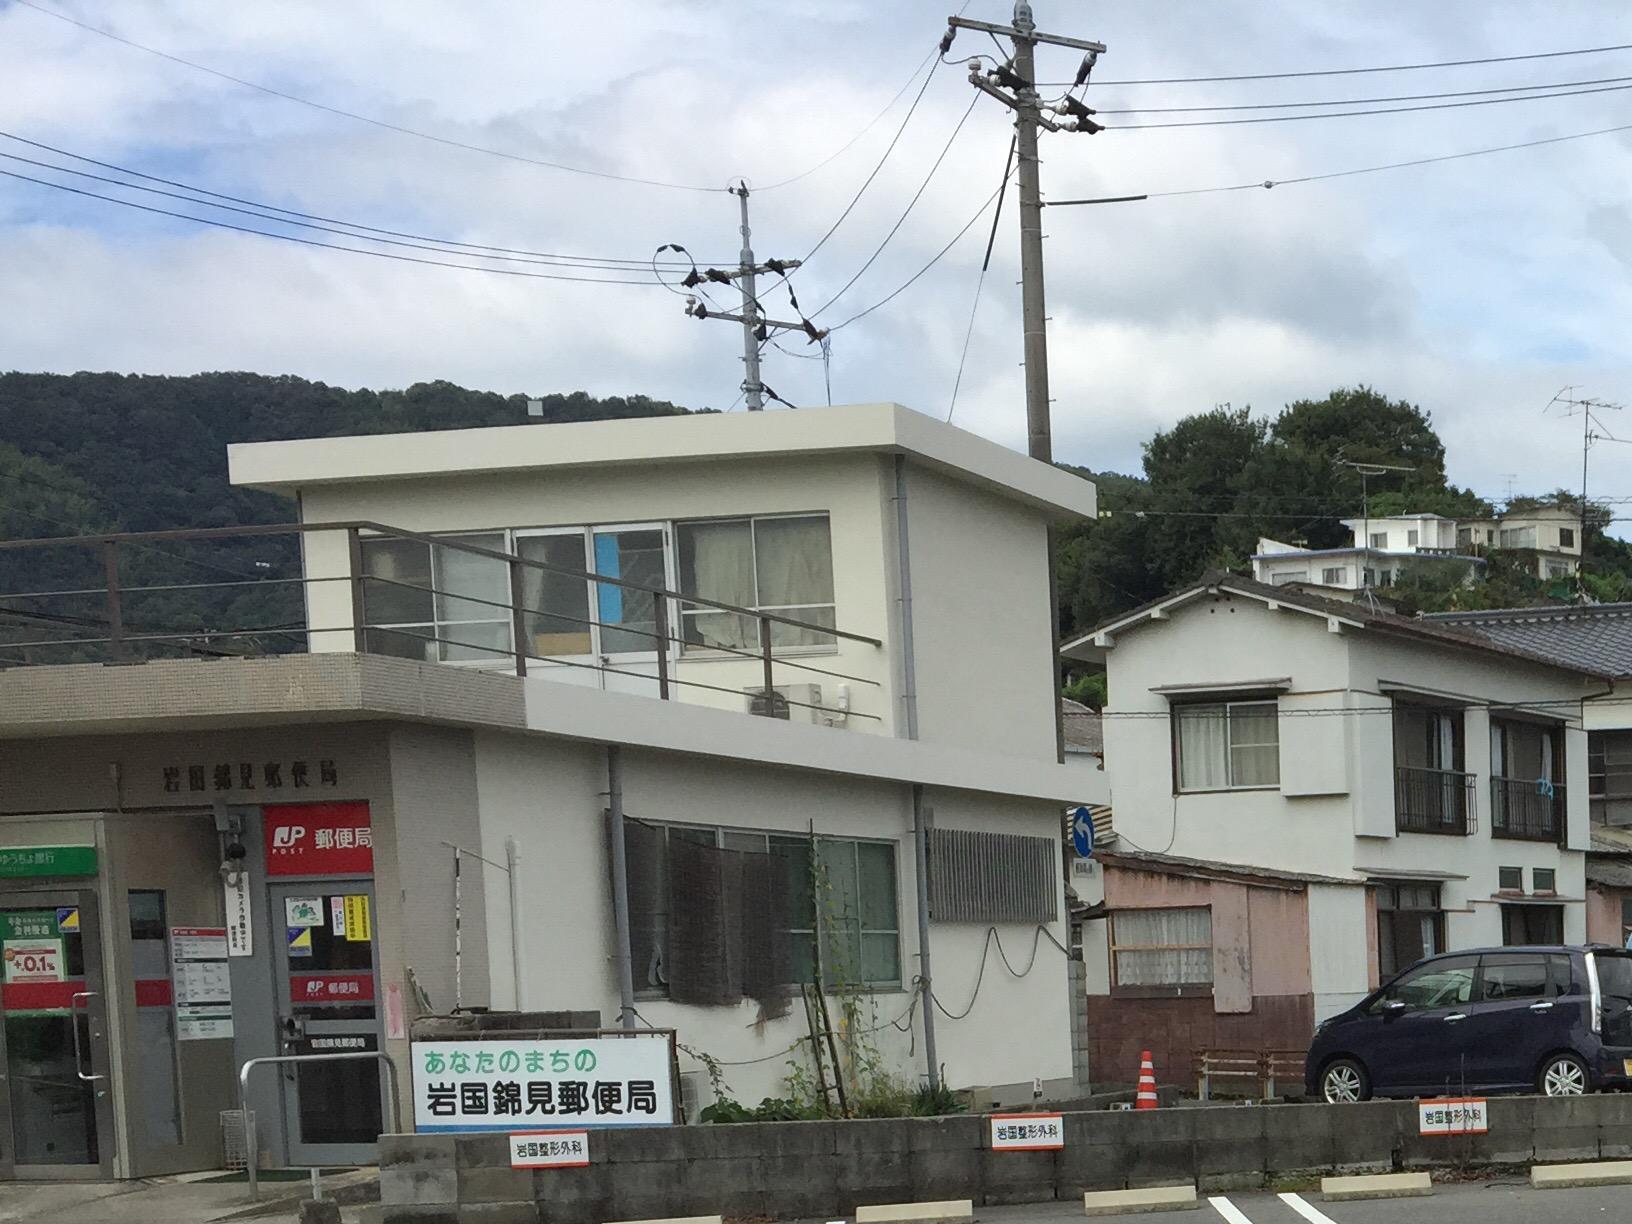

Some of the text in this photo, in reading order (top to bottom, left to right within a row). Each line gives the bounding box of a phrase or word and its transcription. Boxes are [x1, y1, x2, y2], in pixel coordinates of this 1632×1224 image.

[163, 760, 338, 792] 岩国錦見郵便局
[315, 827, 373, 849] 郵便局
[328, 982, 359, 994] 郵便局
[424, 1049, 597, 1074] あなたのまちの
[427, 1080, 657, 1117] 岩国錦見郵便局
[1425, 1107, 1481, 1125] 岩国整形外科
[997, 1123, 1058, 1140] 岩国整形外科
[516, 1140, 583, 1158] 岩国整形外科
